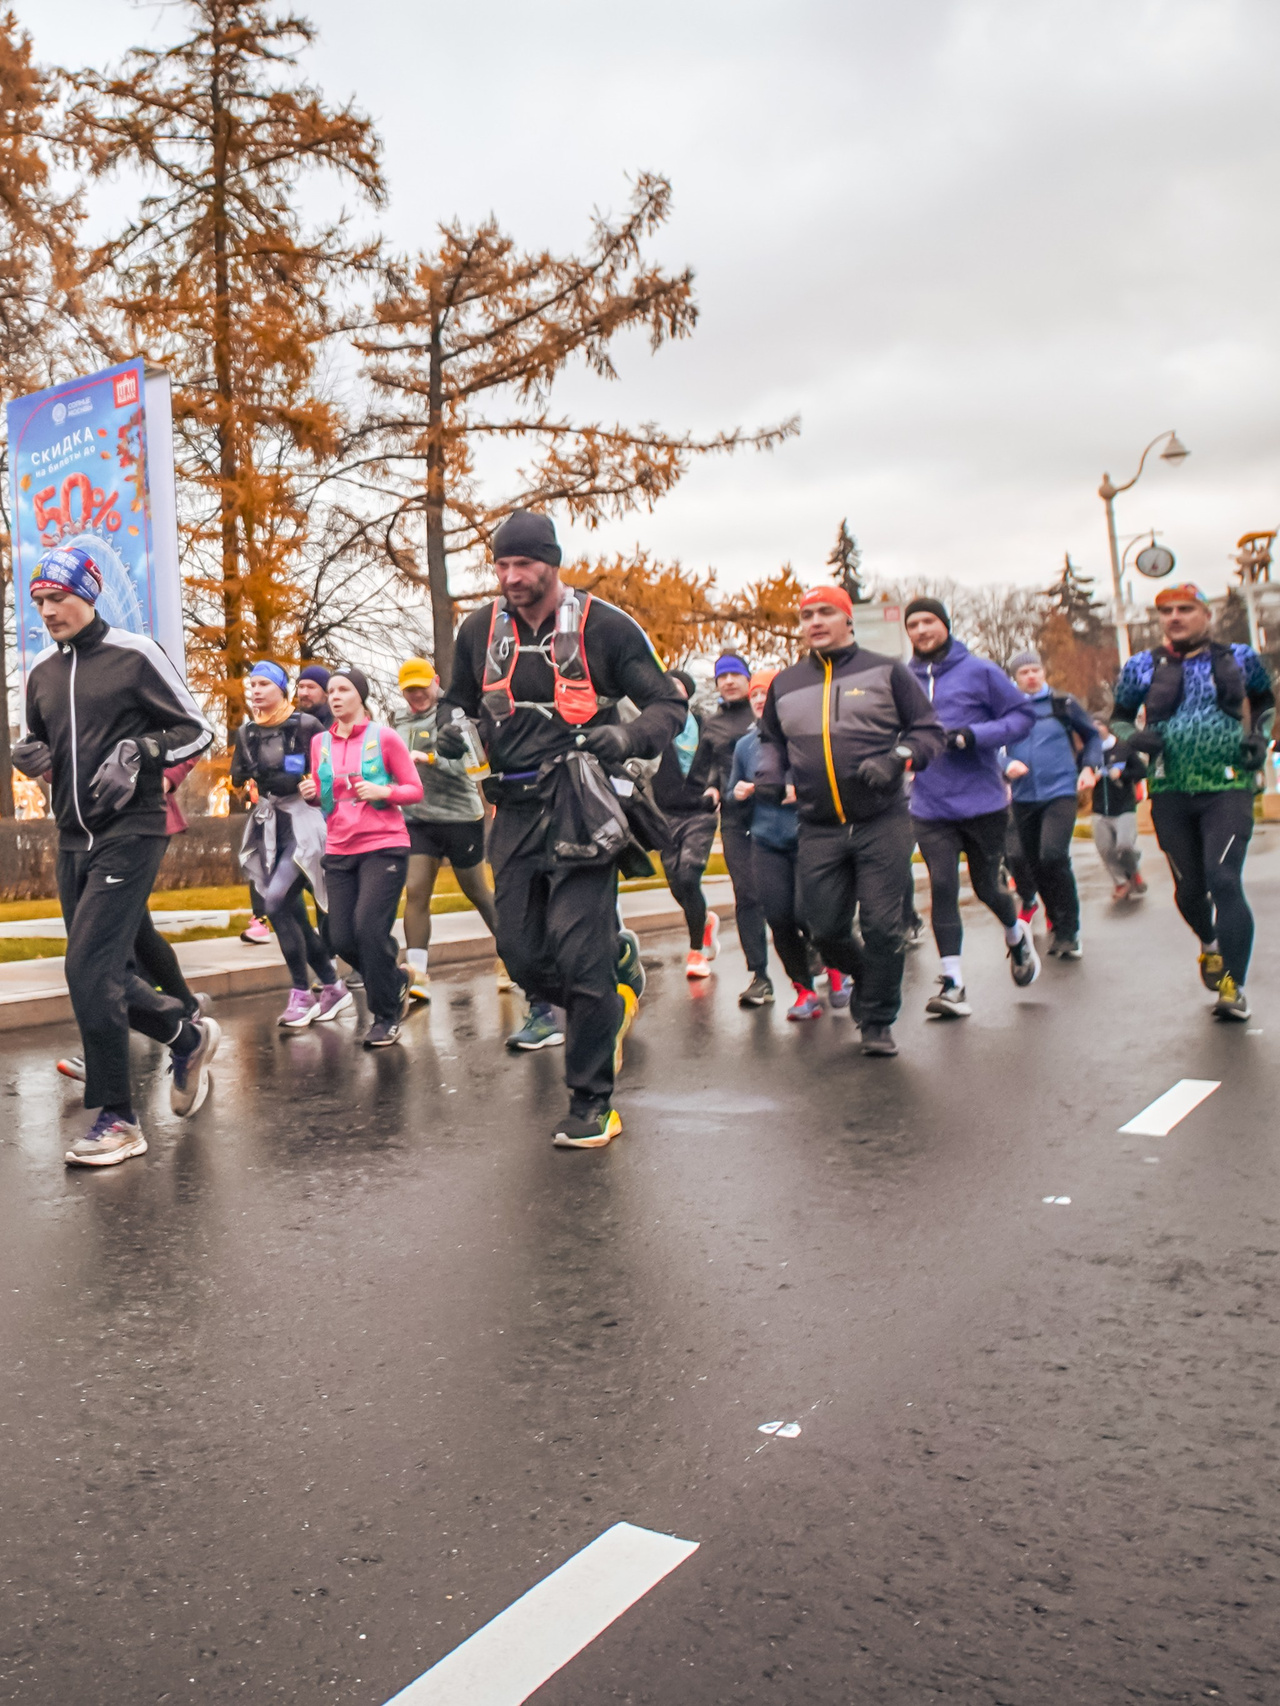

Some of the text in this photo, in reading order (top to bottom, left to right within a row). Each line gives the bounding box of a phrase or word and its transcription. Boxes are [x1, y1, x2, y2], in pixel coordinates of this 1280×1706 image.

[31, 426, 94, 465] СКИДКА
[35, 445, 96, 478] на билеты до
[32, 472, 122, 547] 50%
